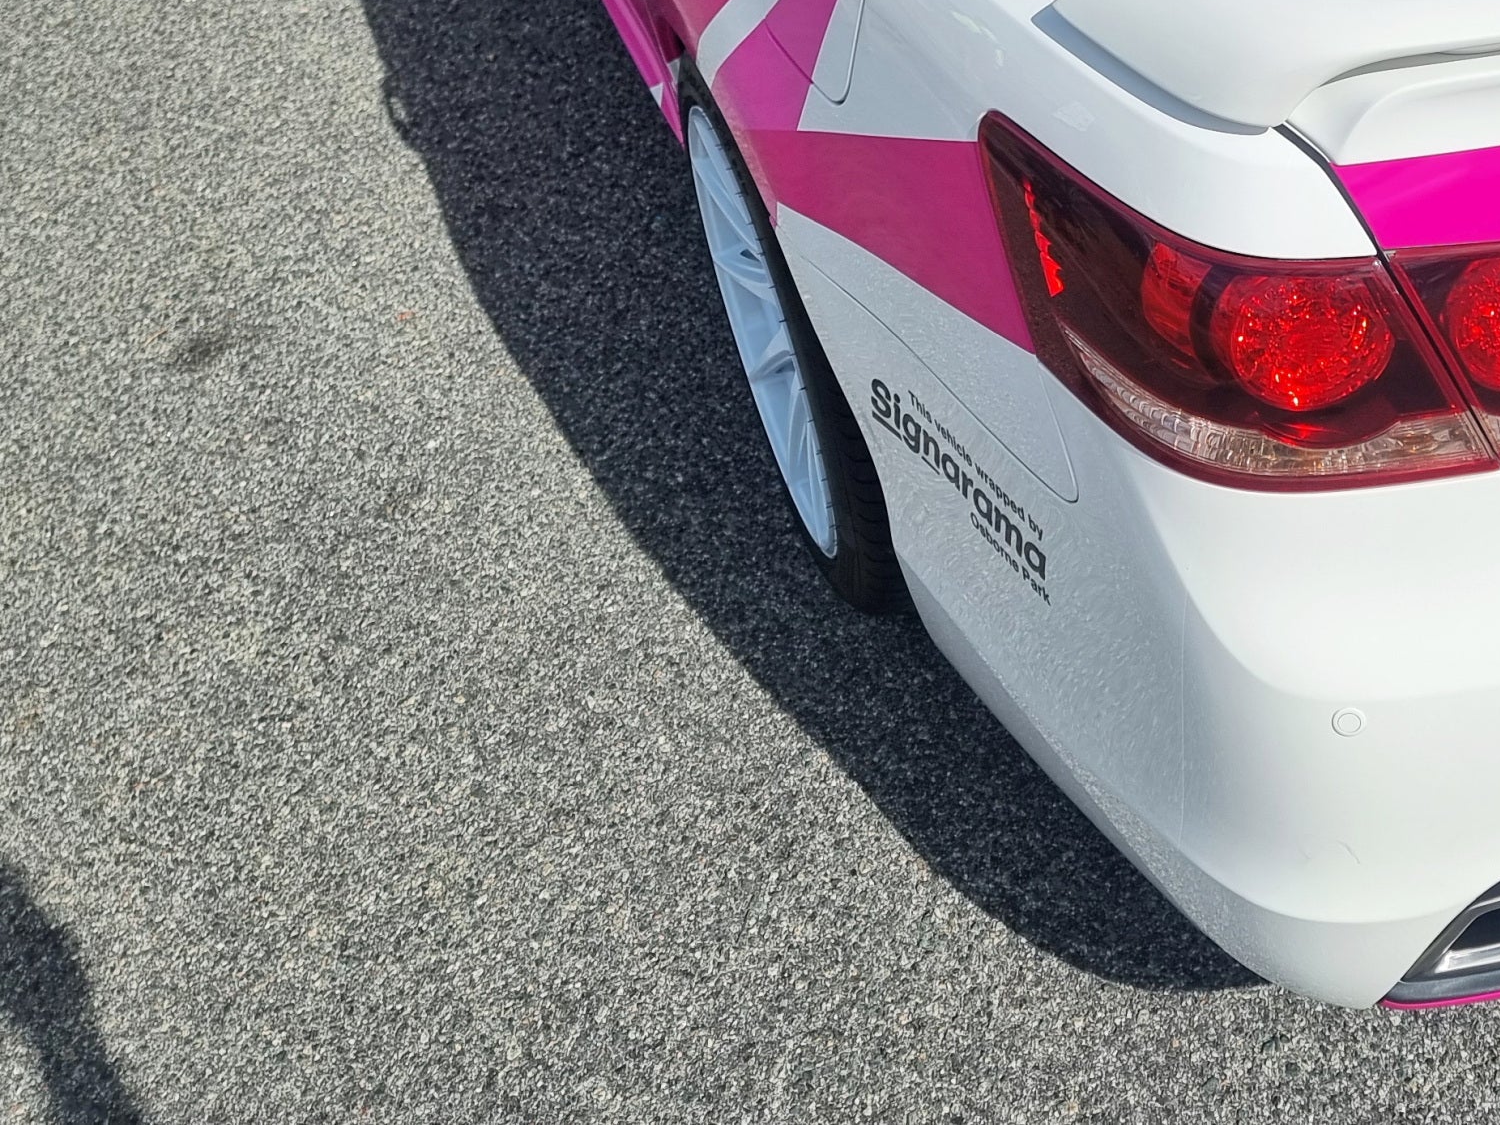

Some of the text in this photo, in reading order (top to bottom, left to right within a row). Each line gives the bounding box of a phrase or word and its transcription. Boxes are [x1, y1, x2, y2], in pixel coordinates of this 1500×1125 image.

[870, 378, 1047, 581] Signarama
[907, 389, 1044, 542] This vehicle wrapped by
[970, 511, 1051, 606] Osborne Park
